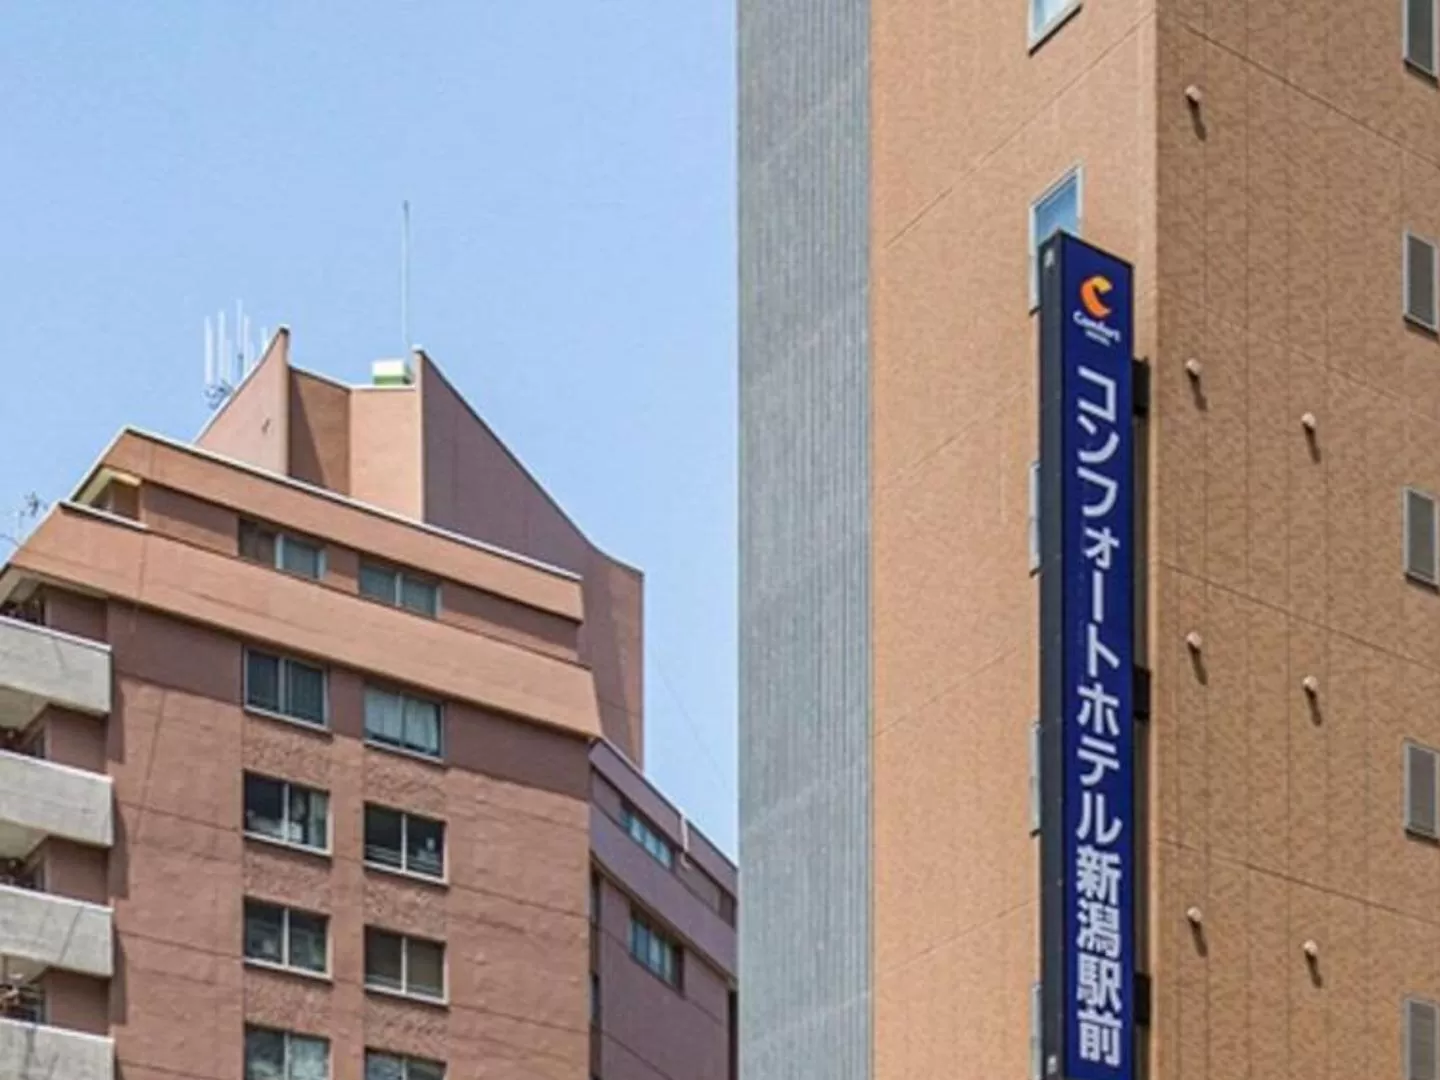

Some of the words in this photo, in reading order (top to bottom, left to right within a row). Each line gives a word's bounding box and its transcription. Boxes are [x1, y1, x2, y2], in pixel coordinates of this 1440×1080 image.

[1076, 365, 1123, 1068] コンフォートホテル新潟駅前
